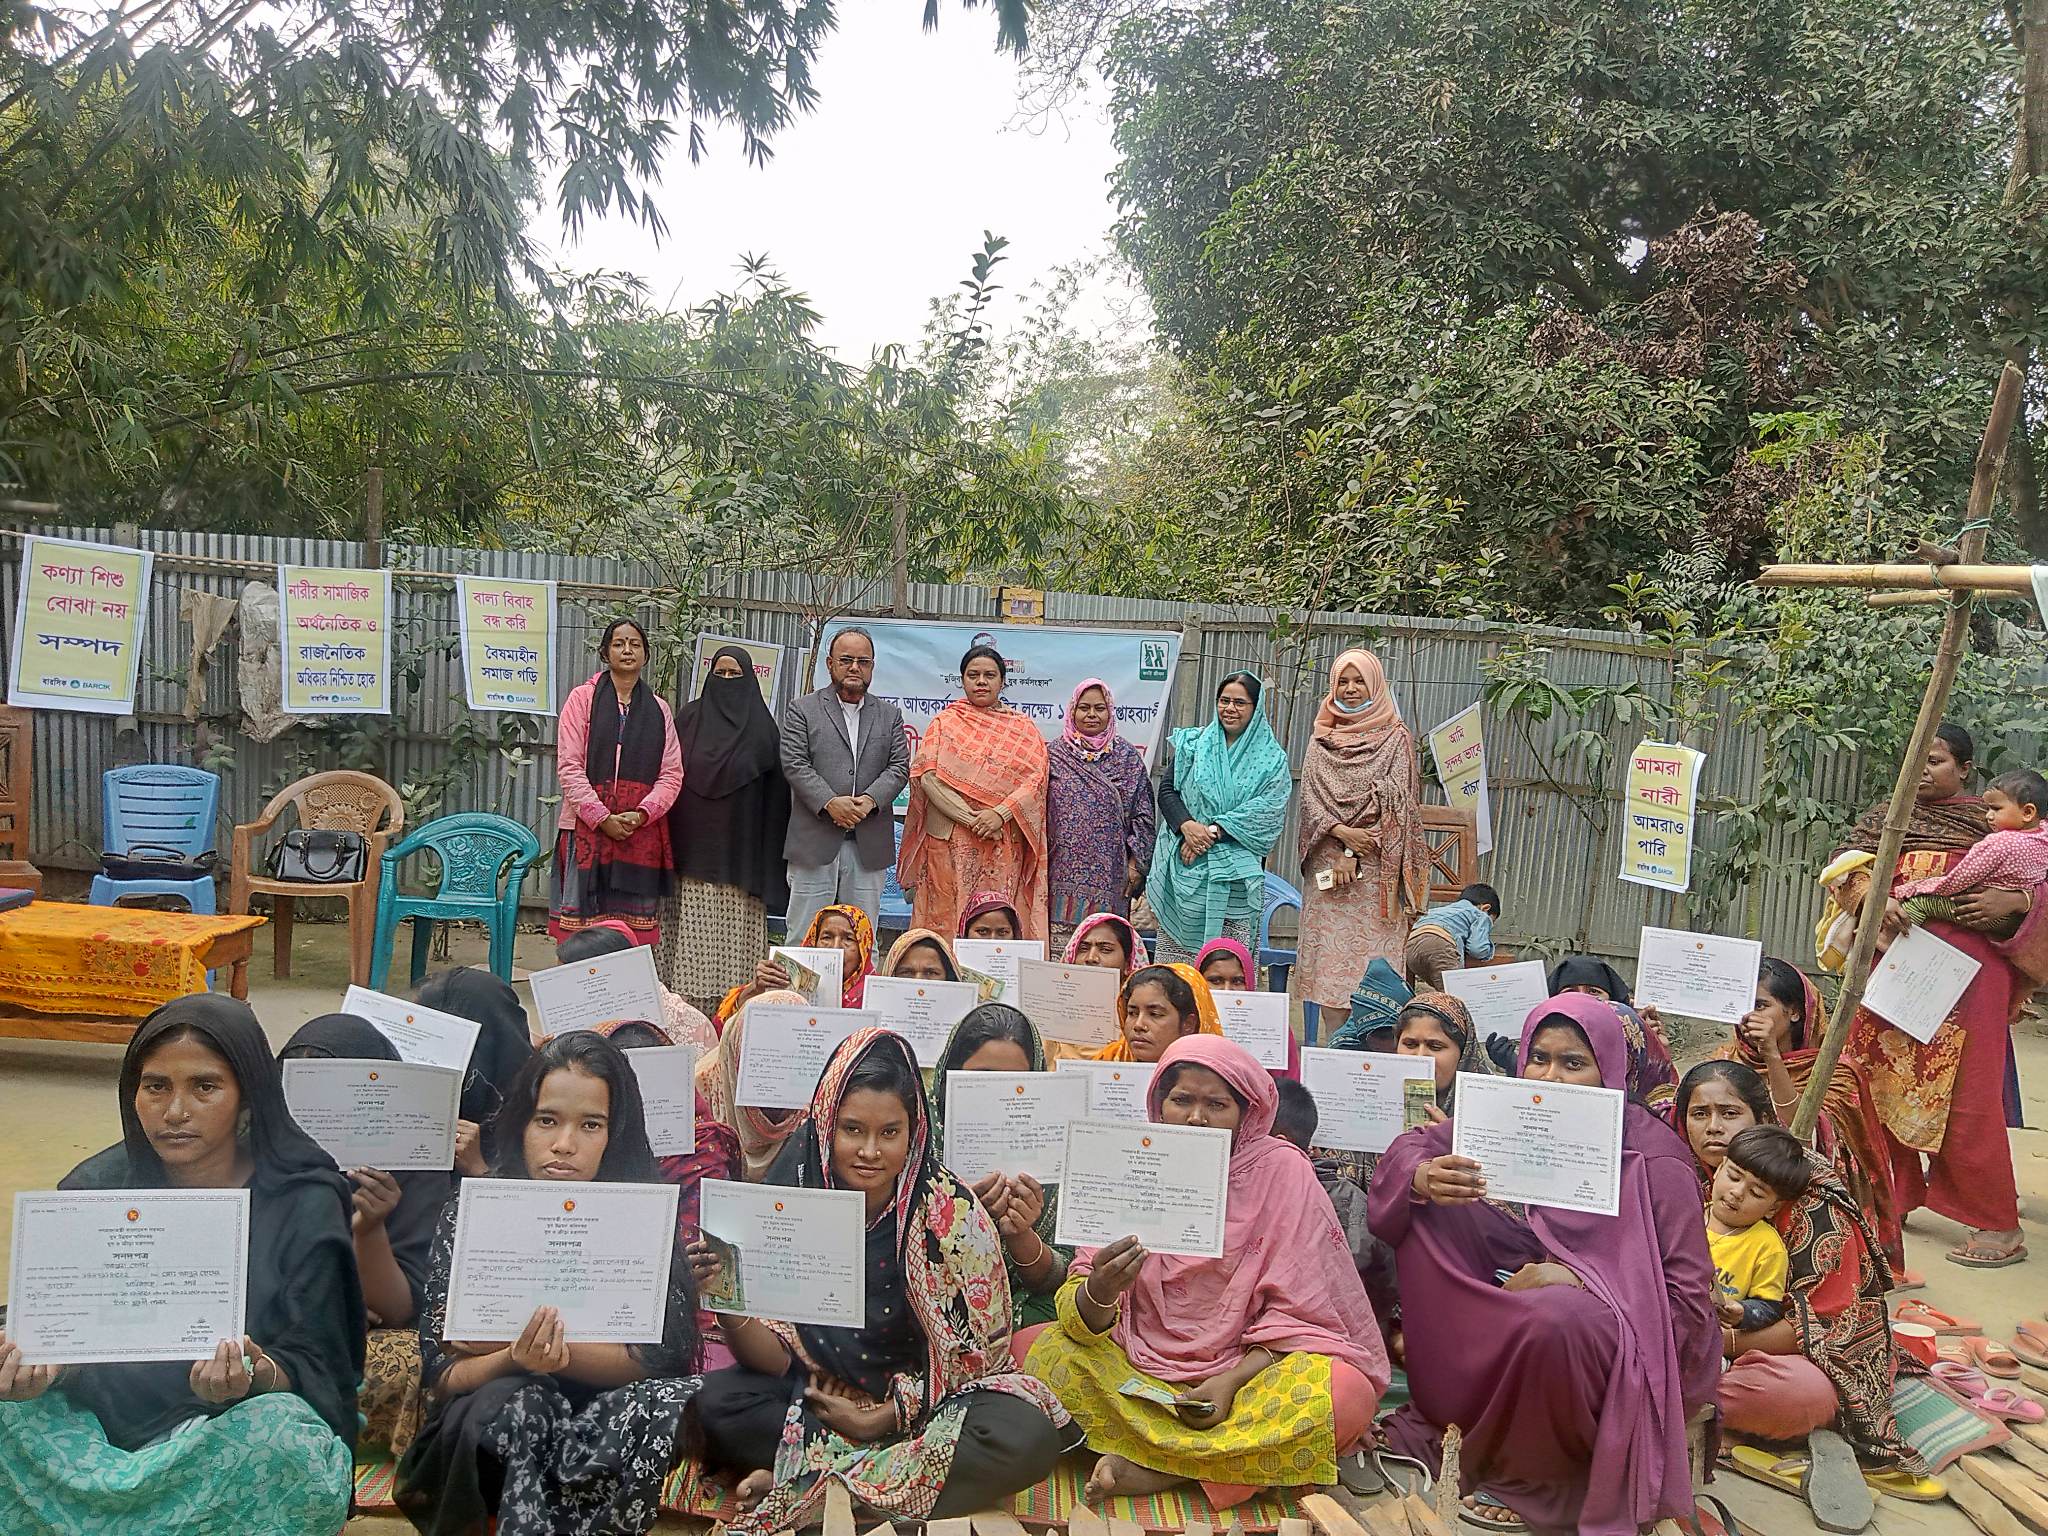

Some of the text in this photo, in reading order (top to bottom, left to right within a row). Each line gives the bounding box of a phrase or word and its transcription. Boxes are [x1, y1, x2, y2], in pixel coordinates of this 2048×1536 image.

[41, 564, 125, 588] কণ্যা শিশু
[288, 579, 370, 602] নারীর সামাজিক
[472, 590, 534, 612] বাল্য বিবাহ
[47, 595, 129, 620] বোঝা নয়
[296, 612, 377, 632] অর্থনৈতিক ও
[482, 613, 528, 630] বন্ধ করি
[37, 633, 125, 657] সম্পদ
[299, 642, 367, 661] রাজনৈতিক
[484, 643, 538, 664] বৈষম্যহীন
[297, 667, 376, 689] অধিকার নিশ্চিত হোক
[481, 667, 538, 685] সমাজ গড়ি
[1021, 702, 1055, 720] লক্ষ্যে
[1448, 725, 1465, 745] আমি
[1444, 742, 1482, 773] সুন্দর ভাবে
[1634, 757, 1683, 778] আমরা
[1639, 785, 1683, 807] নারী
[1632, 814, 1684, 835] আমরাও
[1637, 838, 1668, 858] পারি
